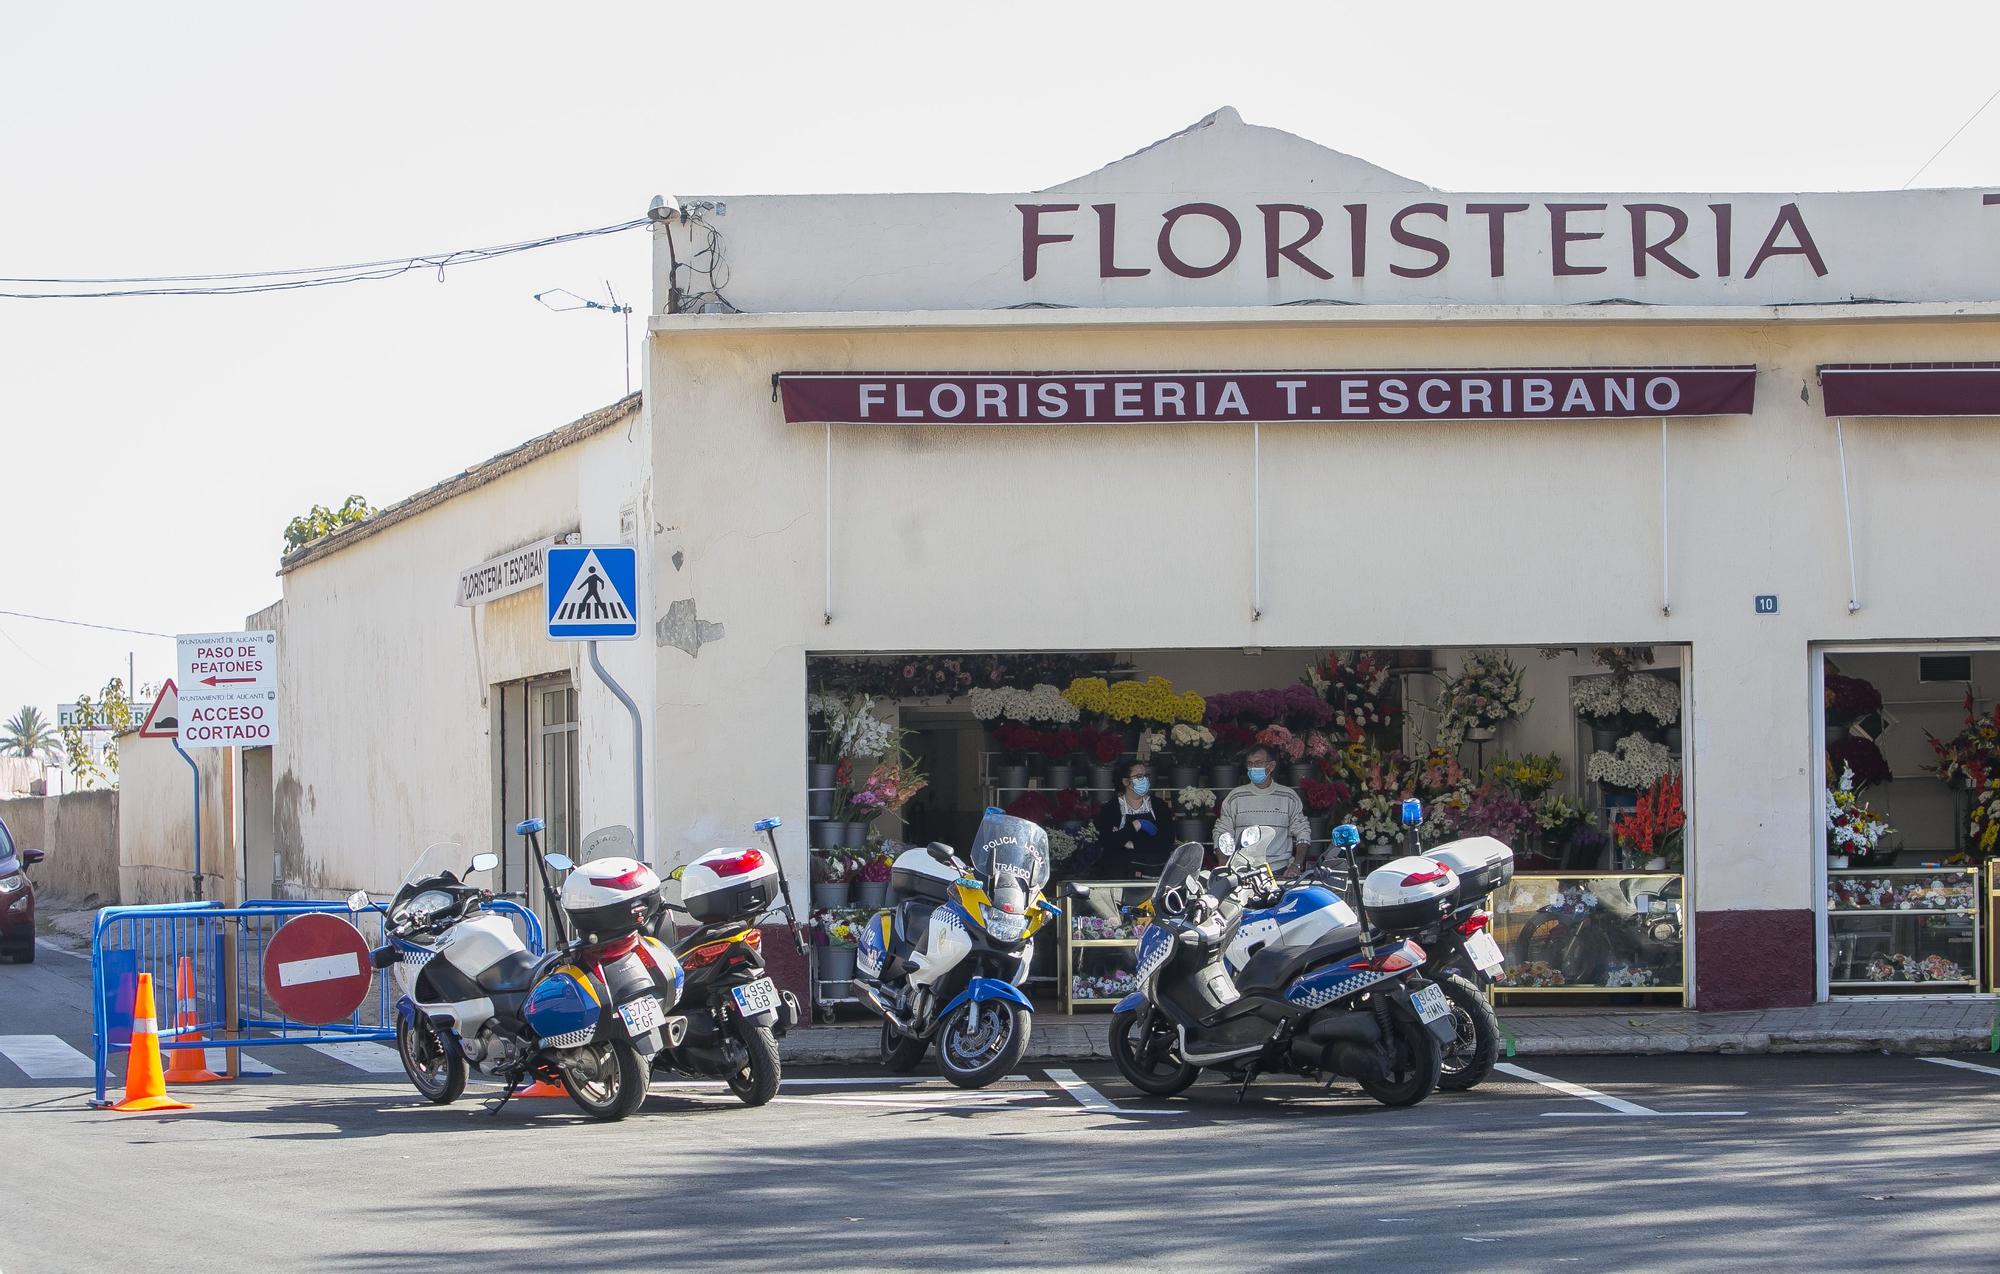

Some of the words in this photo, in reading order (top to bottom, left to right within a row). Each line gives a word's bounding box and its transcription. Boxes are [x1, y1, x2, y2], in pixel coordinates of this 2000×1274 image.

[1014, 201, 1829, 281] FLORISTERIA
[858, 381, 1250, 418] FLORISTERIA
[1276, 380, 1320, 415] T.
[1340, 376, 1681, 415] ESCRIBANO
[1759, 598, 1773, 610] 10
[178, 637, 224, 646] AYUNTAMIENTO
[226, 636, 233, 644] DE
[197, 647, 234, 659] PASO
[238, 646, 256, 657] DE
[192, 660, 263, 673] PEATONES
[178, 694, 225, 702] AYUNTAMIENTO
[236, 692, 264, 700] ALICANTE
[191, 706, 264, 721] ACCESO
[186, 724, 270, 740] CORTADO
[982, 836, 1018, 852] POLICIA
[1024, 842, 1045, 868] LOCAL
[996, 863, 1031, 879] TRÁFICO
[743, 981, 773, 999] 4958
[1418, 987, 1442, 1005] 9483
[628, 996, 657, 1017] 5705
[747, 994, 771, 1011] LGB
[1424, 1001, 1445, 1019] HMN
[634, 1012, 655, 1031] FGF
